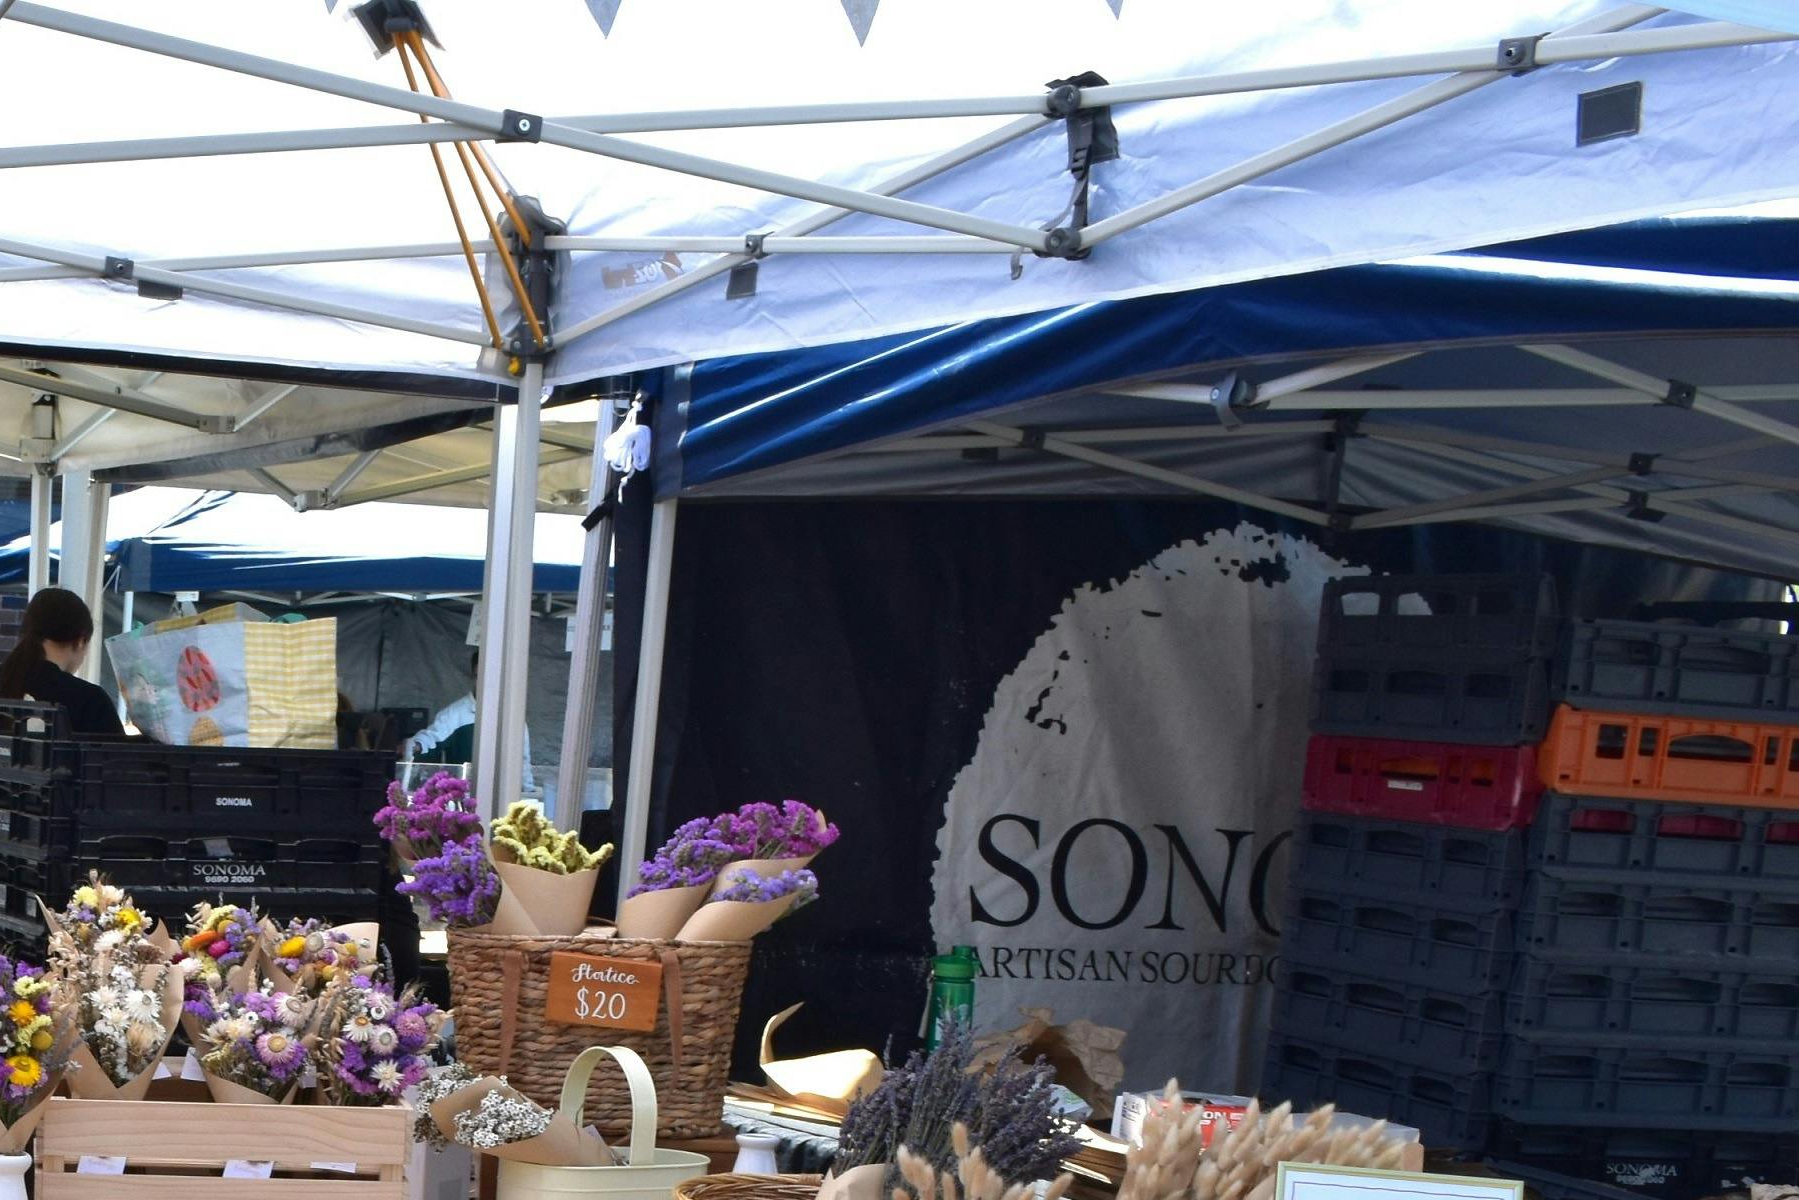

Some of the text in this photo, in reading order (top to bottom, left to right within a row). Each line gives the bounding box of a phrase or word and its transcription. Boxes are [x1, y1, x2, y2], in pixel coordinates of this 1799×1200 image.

[215, 797, 253, 806] SONOMA
[193, 864, 266, 876] SONOMA
[570, 963, 640, 985] Statice
[574, 986, 626, 1020] $20
